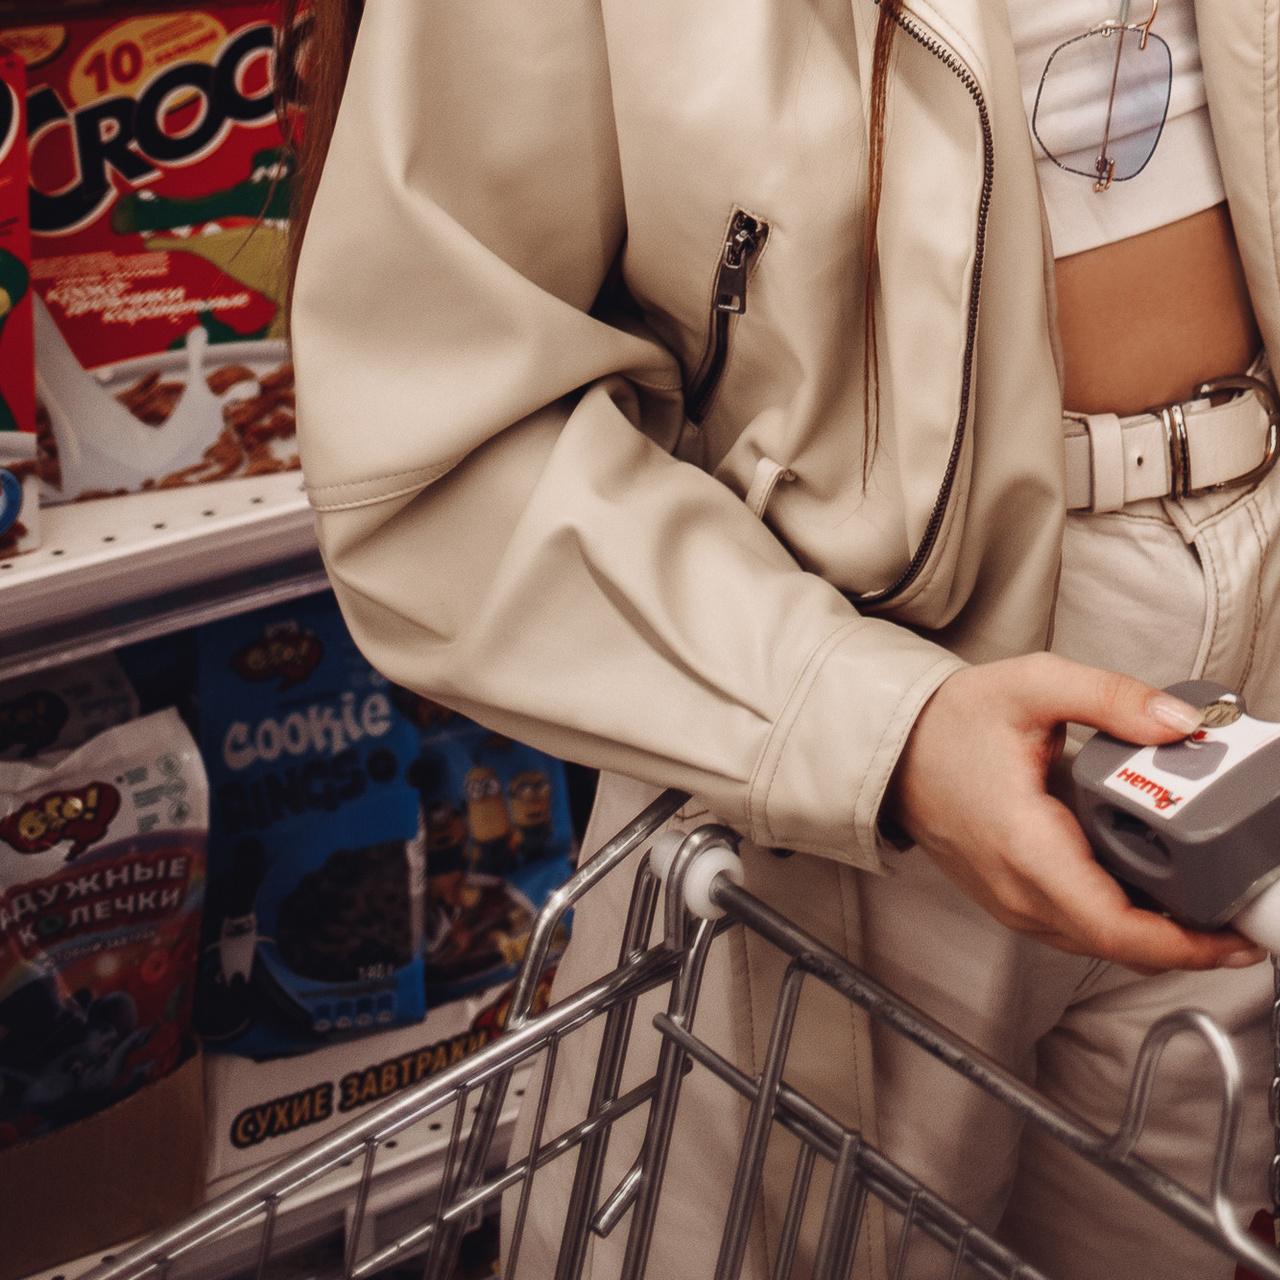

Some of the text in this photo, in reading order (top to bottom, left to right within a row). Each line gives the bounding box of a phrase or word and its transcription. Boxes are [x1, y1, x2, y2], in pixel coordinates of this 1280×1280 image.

[84, 40, 144, 95] 10
[1116, 766, 1184, 812] Ашан
[233, 1030, 489, 1146] СУХИЕ ЗАВТРАКИ
